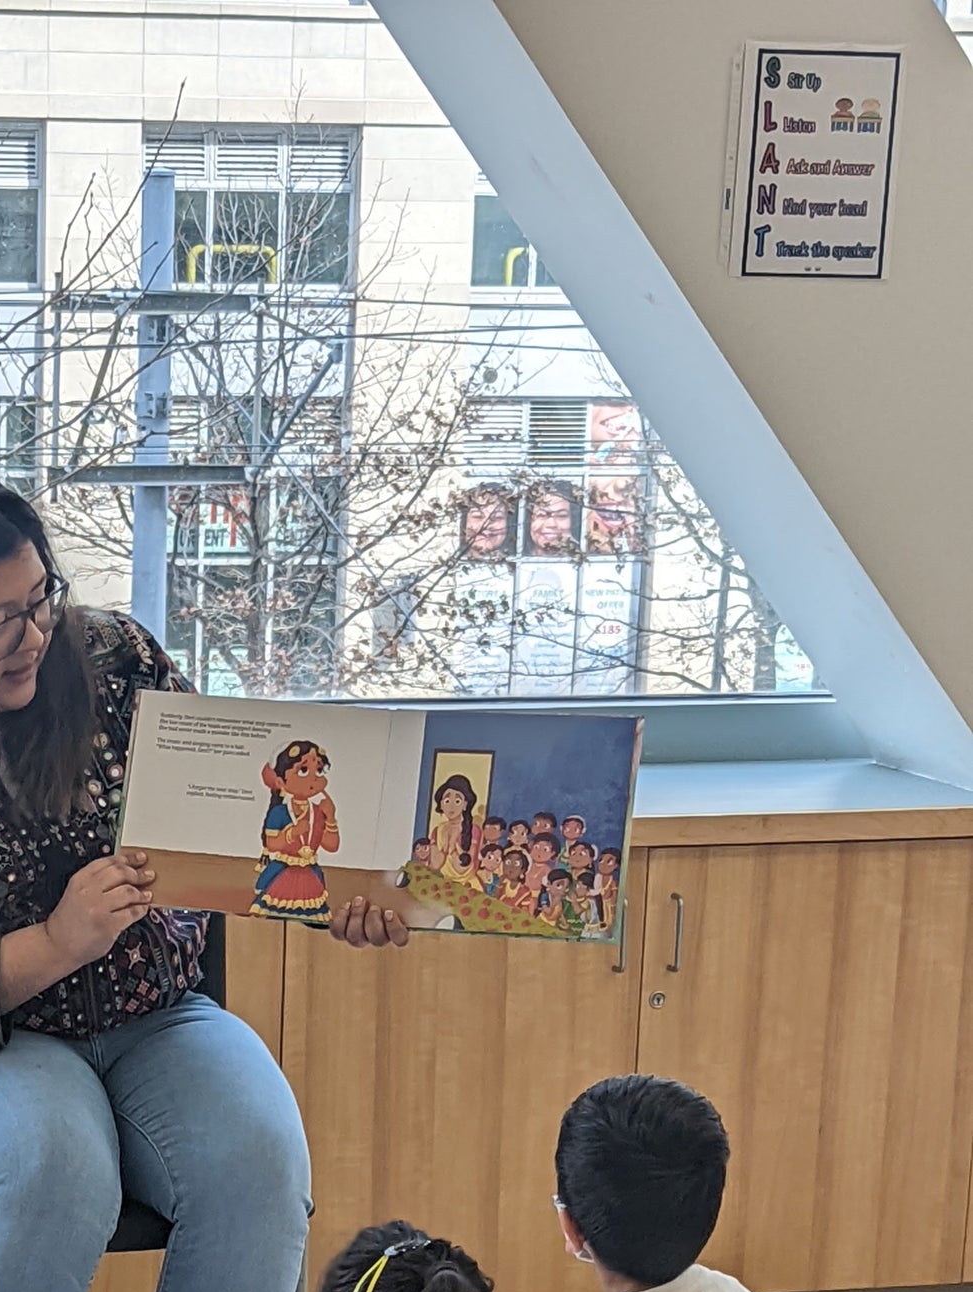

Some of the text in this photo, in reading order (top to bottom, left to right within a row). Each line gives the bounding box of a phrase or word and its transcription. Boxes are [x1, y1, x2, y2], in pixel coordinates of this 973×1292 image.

[764, 56, 781, 89] S
[805, 73, 822, 93] Up
[763, 100, 816, 133] L Listen
[759, 142, 875, 176] A Ask and Answer
[756, 183, 777, 215] N
[783, 198, 806, 215] Nod
[808, 203, 836, 219] your
[754, 225, 876, 261] T Track the speaker
